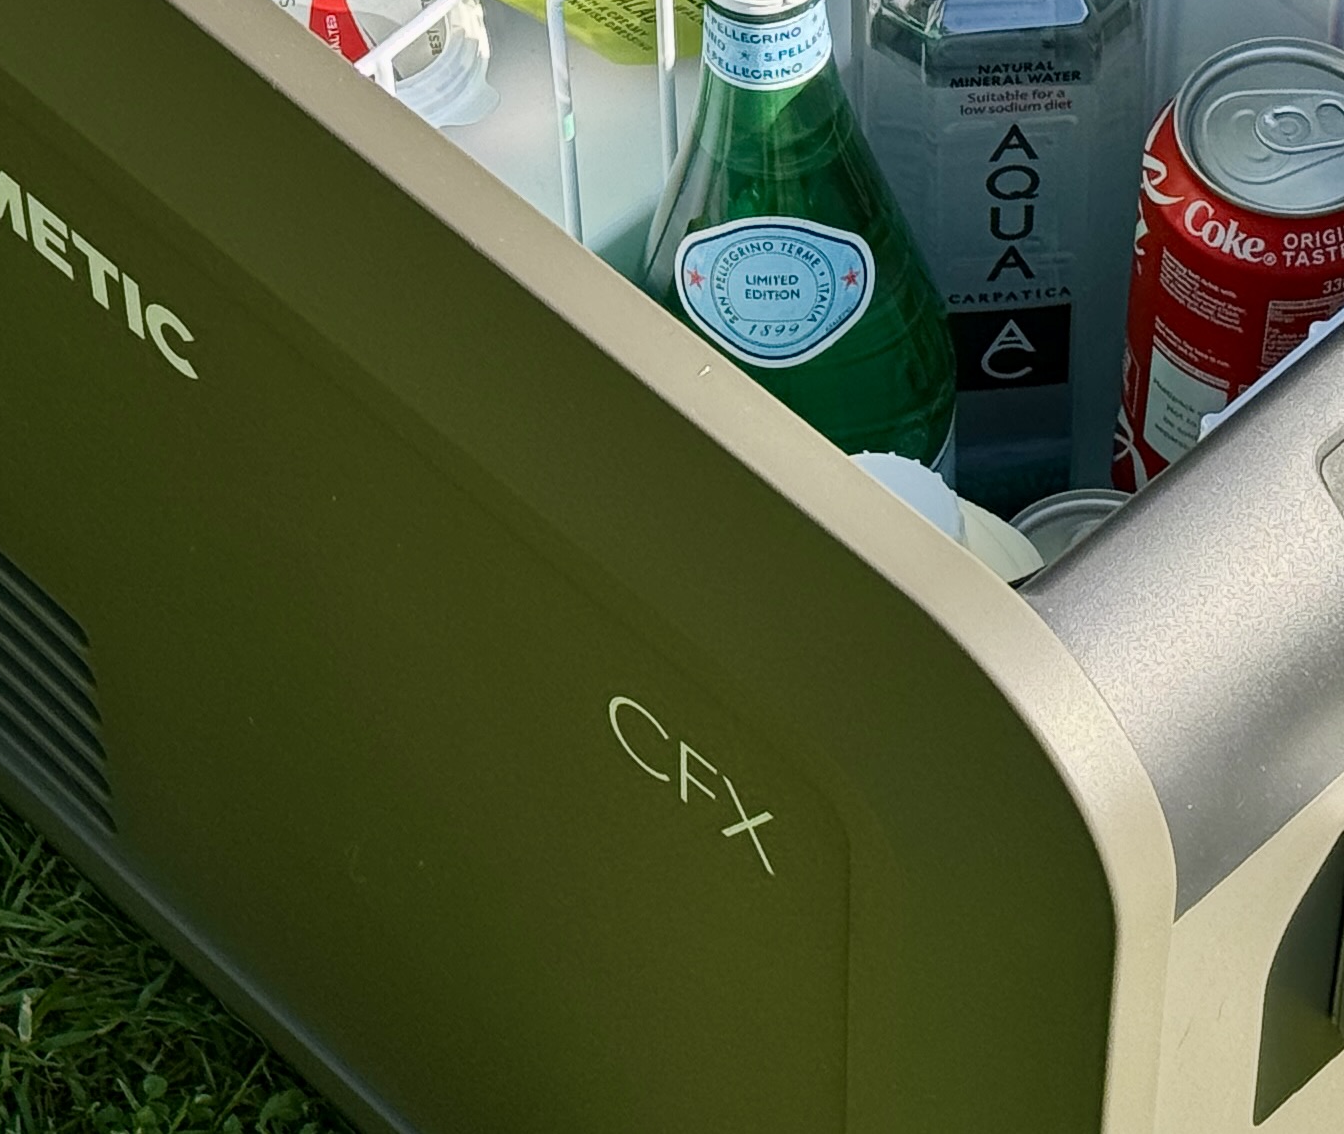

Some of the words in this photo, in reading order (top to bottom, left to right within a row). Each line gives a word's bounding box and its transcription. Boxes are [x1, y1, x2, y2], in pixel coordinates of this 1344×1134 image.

[325, 14, 342, 50] ALTED
[978, 60, 1055, 74] NATURAL
[950, 74, 1023, 88] MINERAL
[1028, 70, 1081, 84] WATER
[967, 90, 1029, 104] Suitable
[1032, 88, 1052, 100] for
[1056, 89, 1065, 99] a
[960, 104, 986, 116] low
[988, 101, 1042, 114] sodium
[1043, 98, 1073, 111] diet
[985, 123, 1041, 282] AQUA
[781, 242, 821, 269] TERME
[714, 241, 774, 292] PELLEGRINO
[745, 274, 799, 286] LIMITED
[745, 288, 801, 301] EDITION
[806, 283, 830, 324] ITALIA
[948, 286, 1072, 305] CARPATICA
[720, 296, 740, 325] SAN
[747, 322, 800, 337] 1899
[608, 695, 775, 877] CFX
